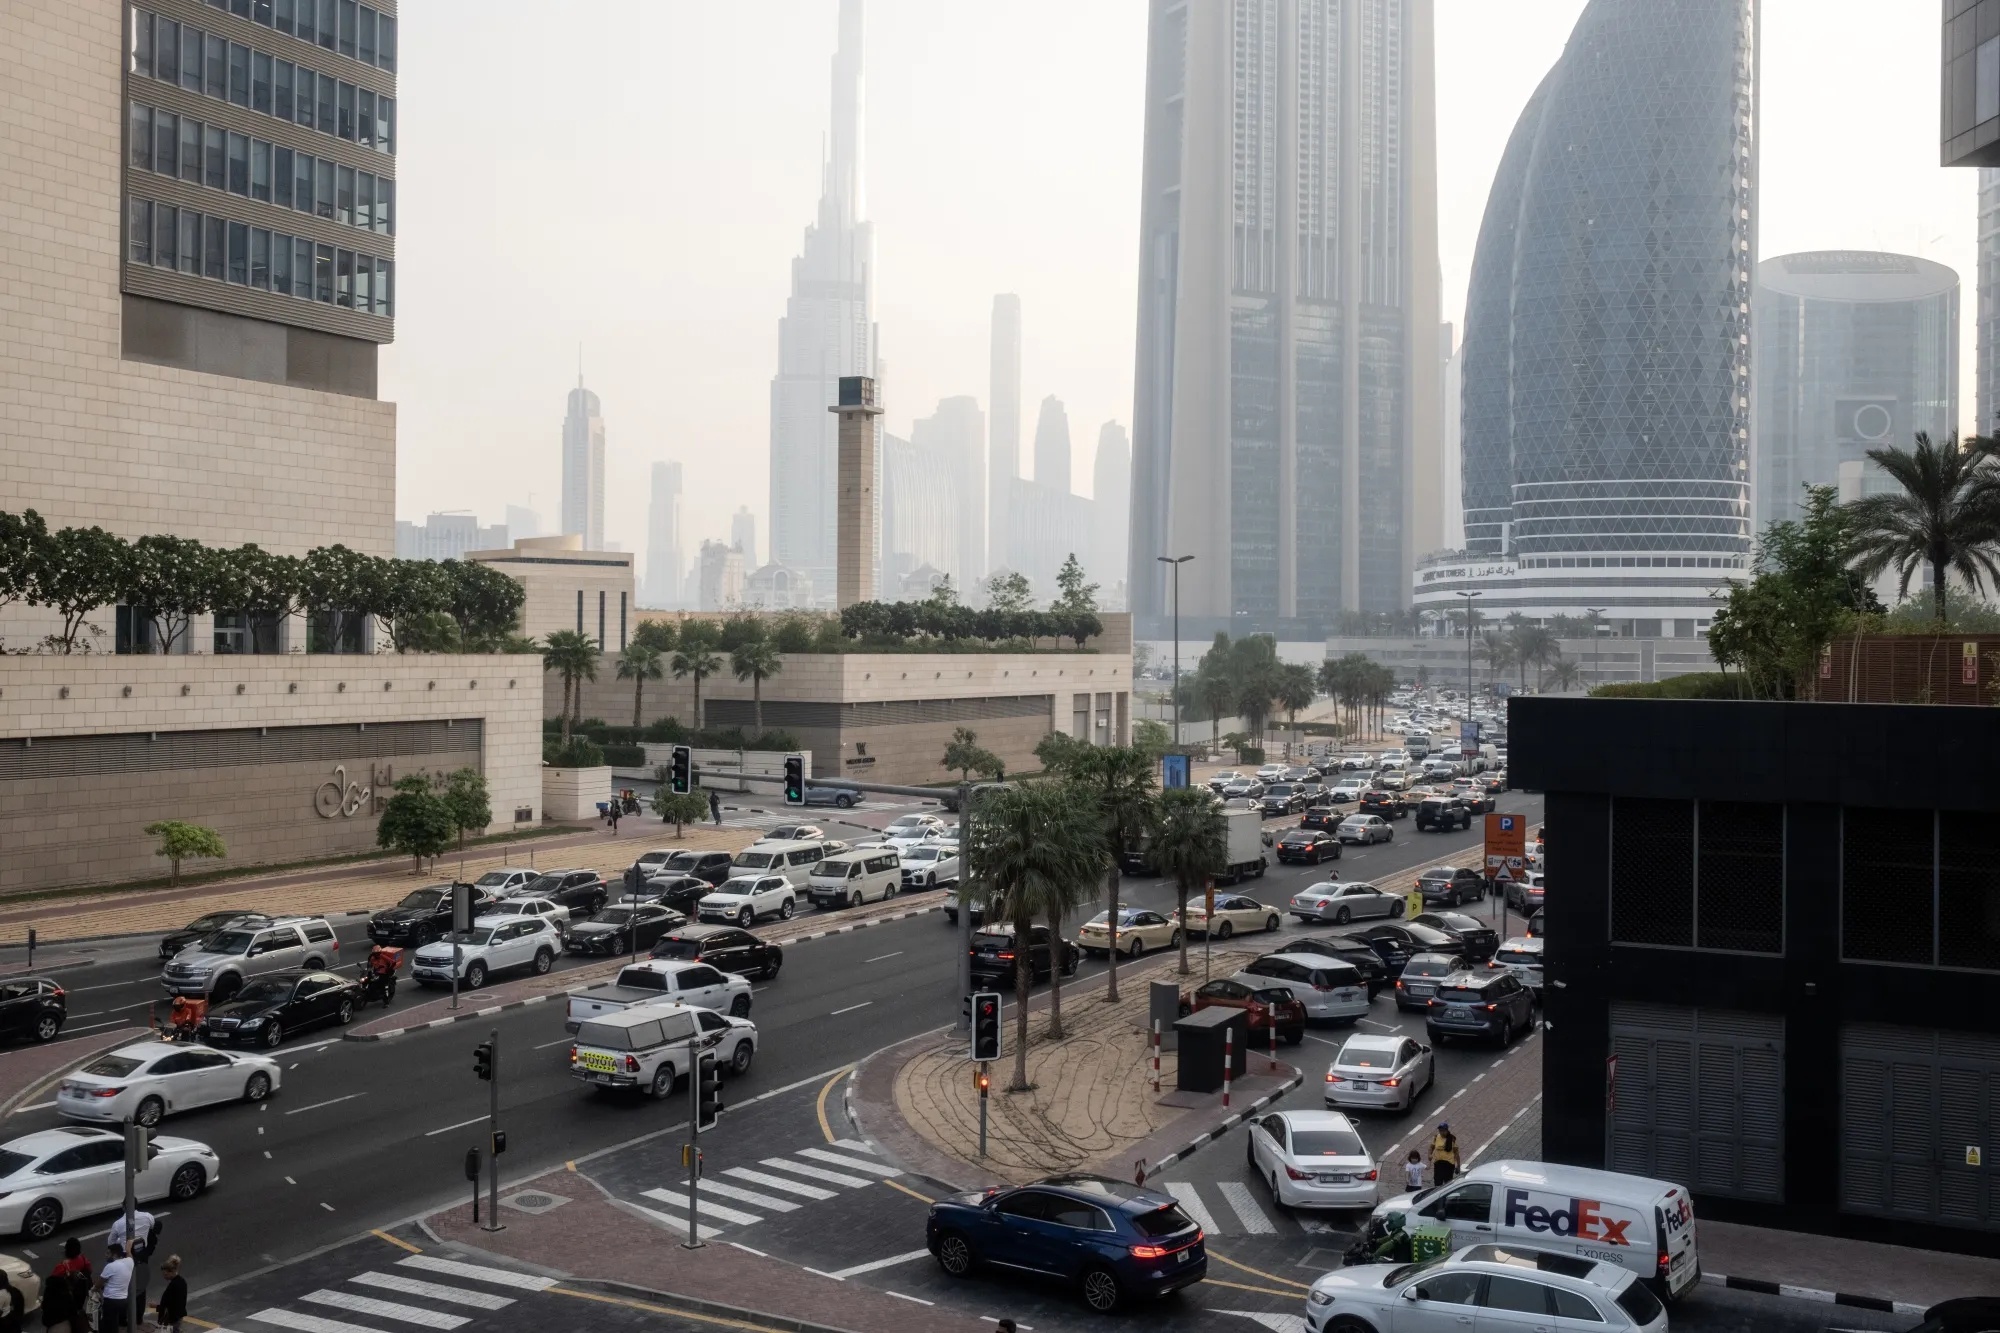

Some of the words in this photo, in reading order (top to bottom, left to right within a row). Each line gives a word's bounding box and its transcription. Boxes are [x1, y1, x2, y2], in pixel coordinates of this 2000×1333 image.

[1501, 817, 1512, 829] P
[586, 1056, 618, 1069] TOYOTA
[1505, 1188, 1632, 1247] FedEx
[1664, 1198, 1692, 1235] FedEx
[1575, 1244, 1624, 1264] Express
